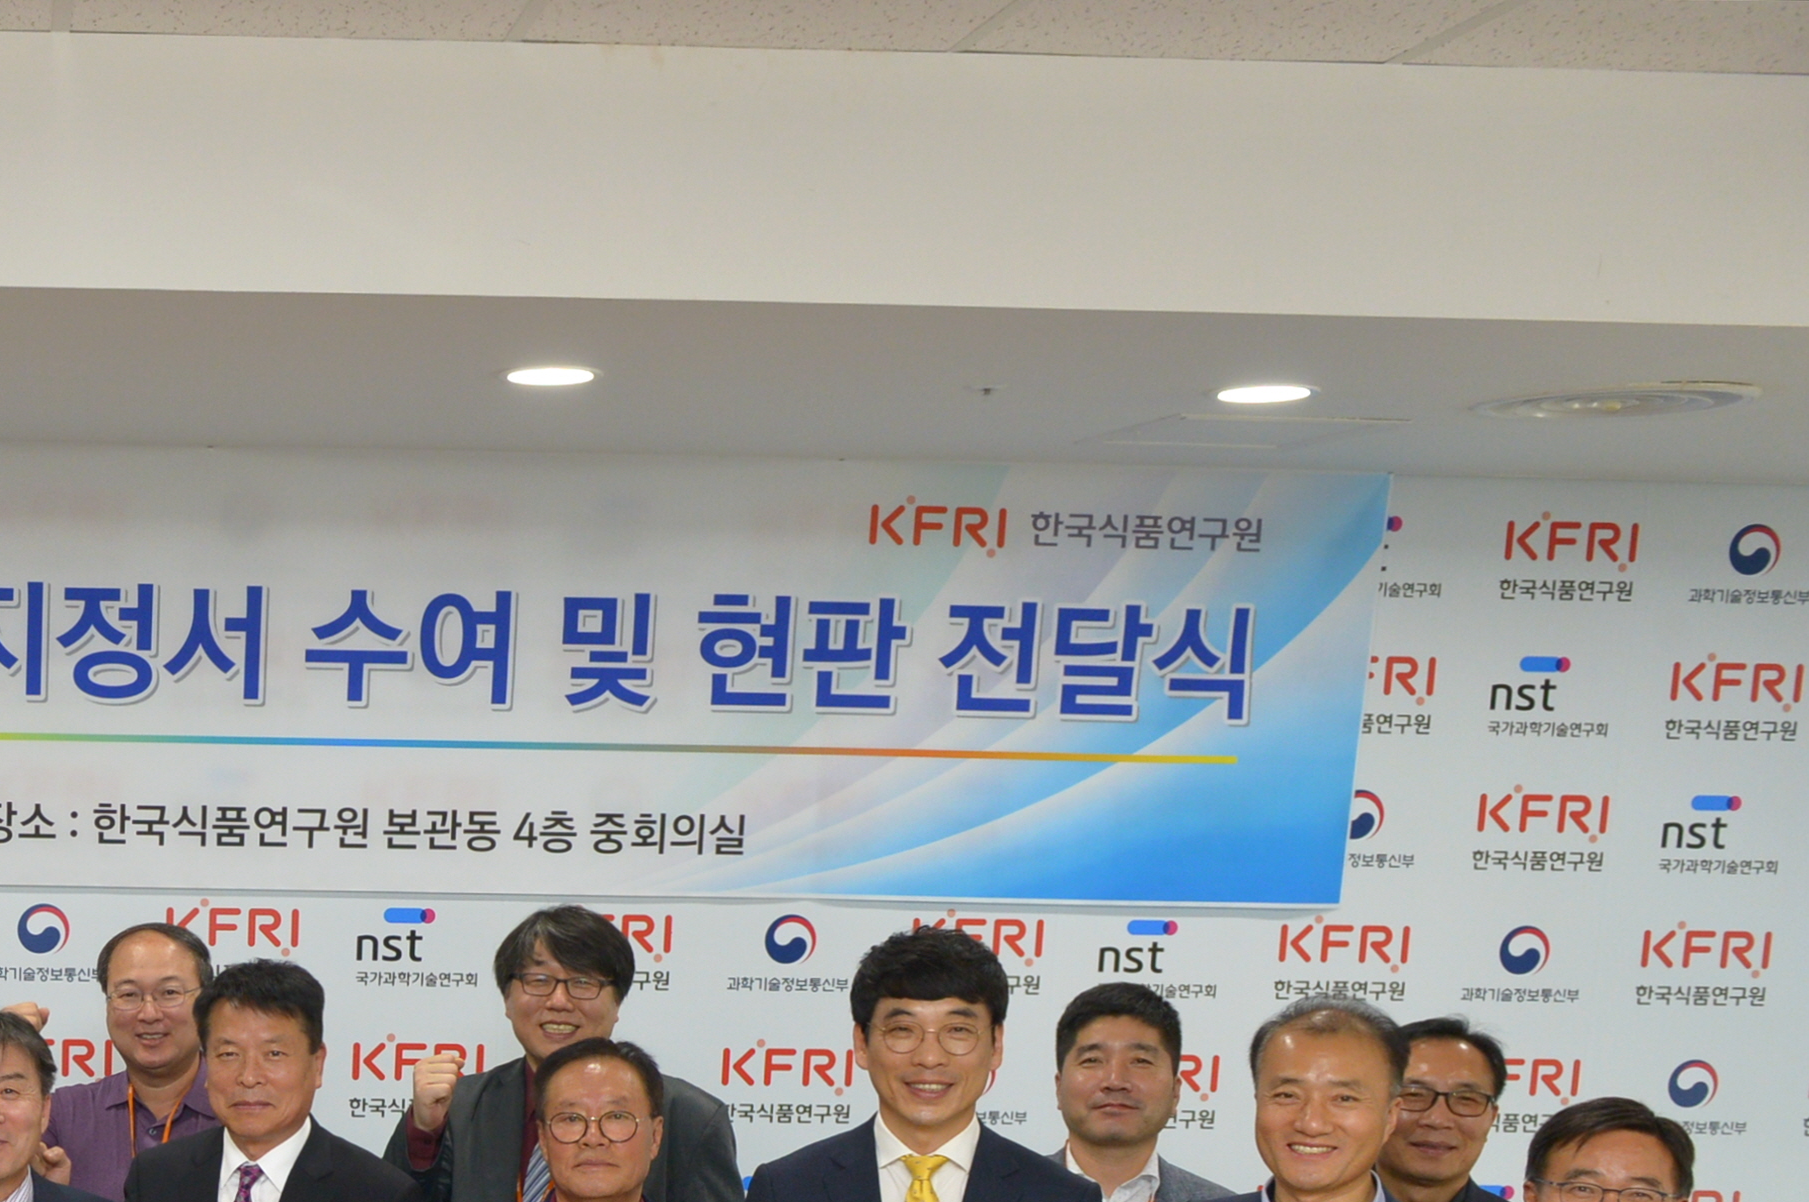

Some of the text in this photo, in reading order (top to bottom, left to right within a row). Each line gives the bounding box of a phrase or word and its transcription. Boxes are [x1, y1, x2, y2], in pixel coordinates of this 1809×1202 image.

[869, 505, 1262, 552] KFRI 한국식품연구원
[1505, 521, 1639, 562] KFRI
[1500, 579, 1633, 602] 한국식품연구원
[305, 590, 512, 704] 수여
[562, 593, 650, 706] 및
[698, 594, 906, 708] 현판
[938, 601, 1253, 723] 전달식
[1490, 679, 1556, 711] nst
[1671, 662, 1804, 703] KFRI
[1488, 721, 1608, 737] 국가과학기술연구회
[1666, 719, 1797, 741] 한국식품연구원
[93, 803, 368, 848] 한국식품연구원
[383, 809, 501, 852] 본관동
[513, 811, 577, 853] 4층
[590, 813, 745, 855] 중회의실
[1477, 794, 1610, 834] KFRI
[1661, 818, 1727, 849] nst
[1348, 853, 1414, 868] 정보통신부
[1473, 850, 1603, 872] 한국식품연구원
[1659, 859, 1778, 875] 국가과학기술연구회
[357, 930, 423, 962] nst
[1098, 942, 1164, 973] nst
[1279, 924, 1410, 964] KFRI
[1641, 930, 1772, 969] KFRI
[356, 972, 477, 987] 국가과학기술연구회
[727, 977, 848, 992] 과학기술정보통신부
[1274, 980, 1405, 1001] 한국식품연구원
[1461, 988, 1579, 1003] 과학기술정보통신부
[1636, 985, 1766, 1006] 한국식품연구원
[721, 1048, 853, 1086] KFRI
